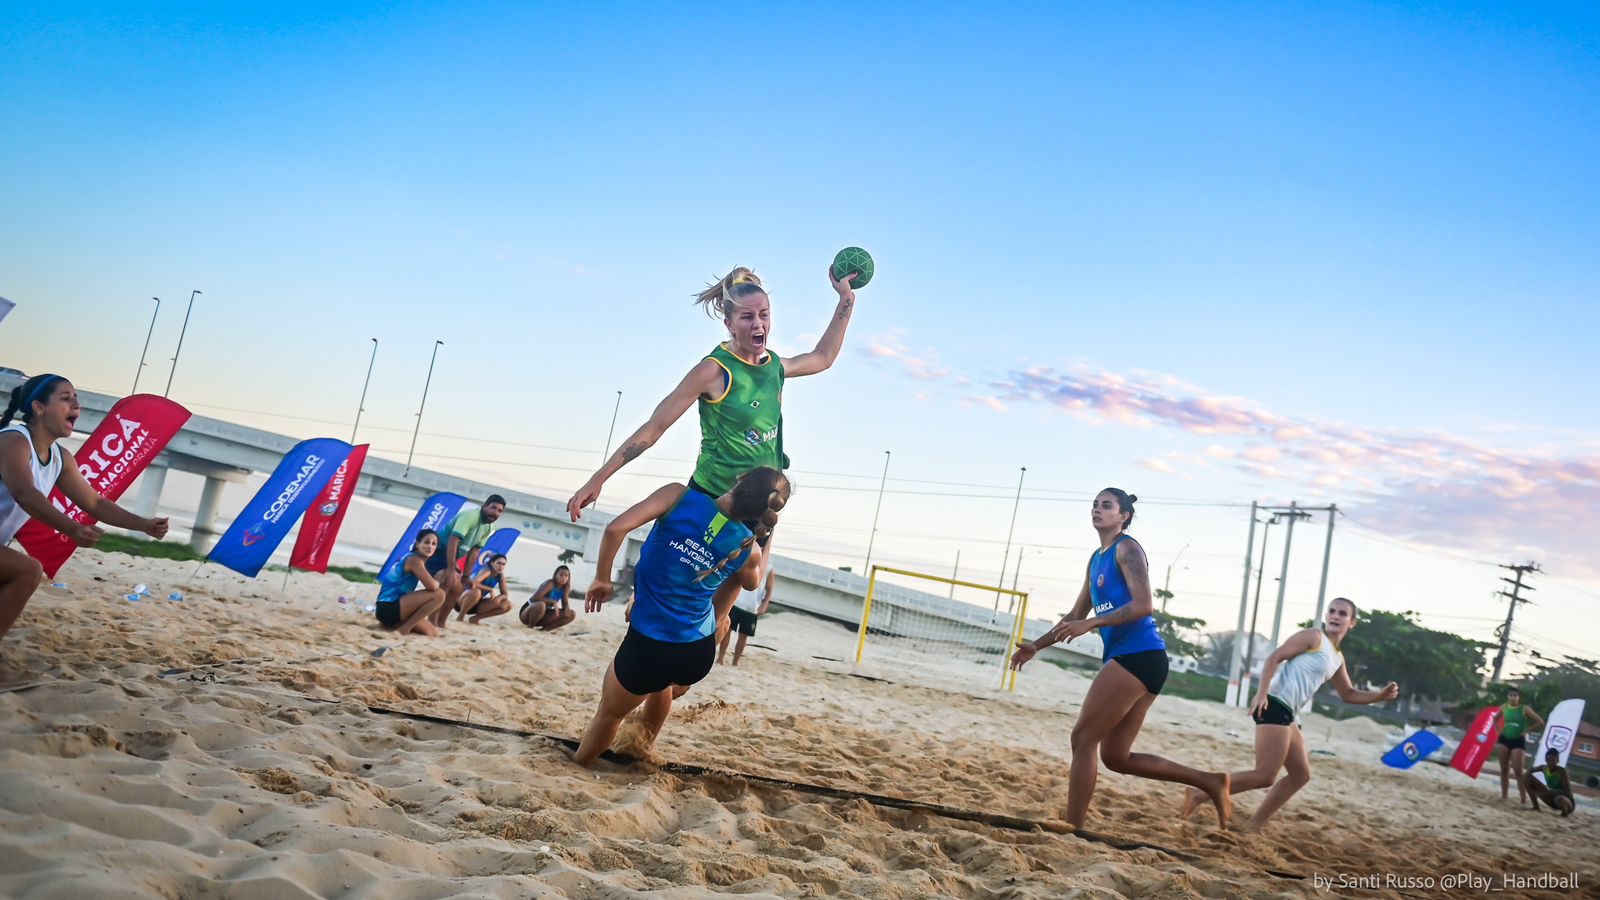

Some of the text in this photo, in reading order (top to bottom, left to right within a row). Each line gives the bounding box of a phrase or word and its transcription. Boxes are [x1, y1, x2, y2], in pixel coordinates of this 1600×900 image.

[98, 429, 149, 491] NACIONAL
[263, 454, 321, 521] CODEMAR
[684, 538, 715, 561] BEAC
